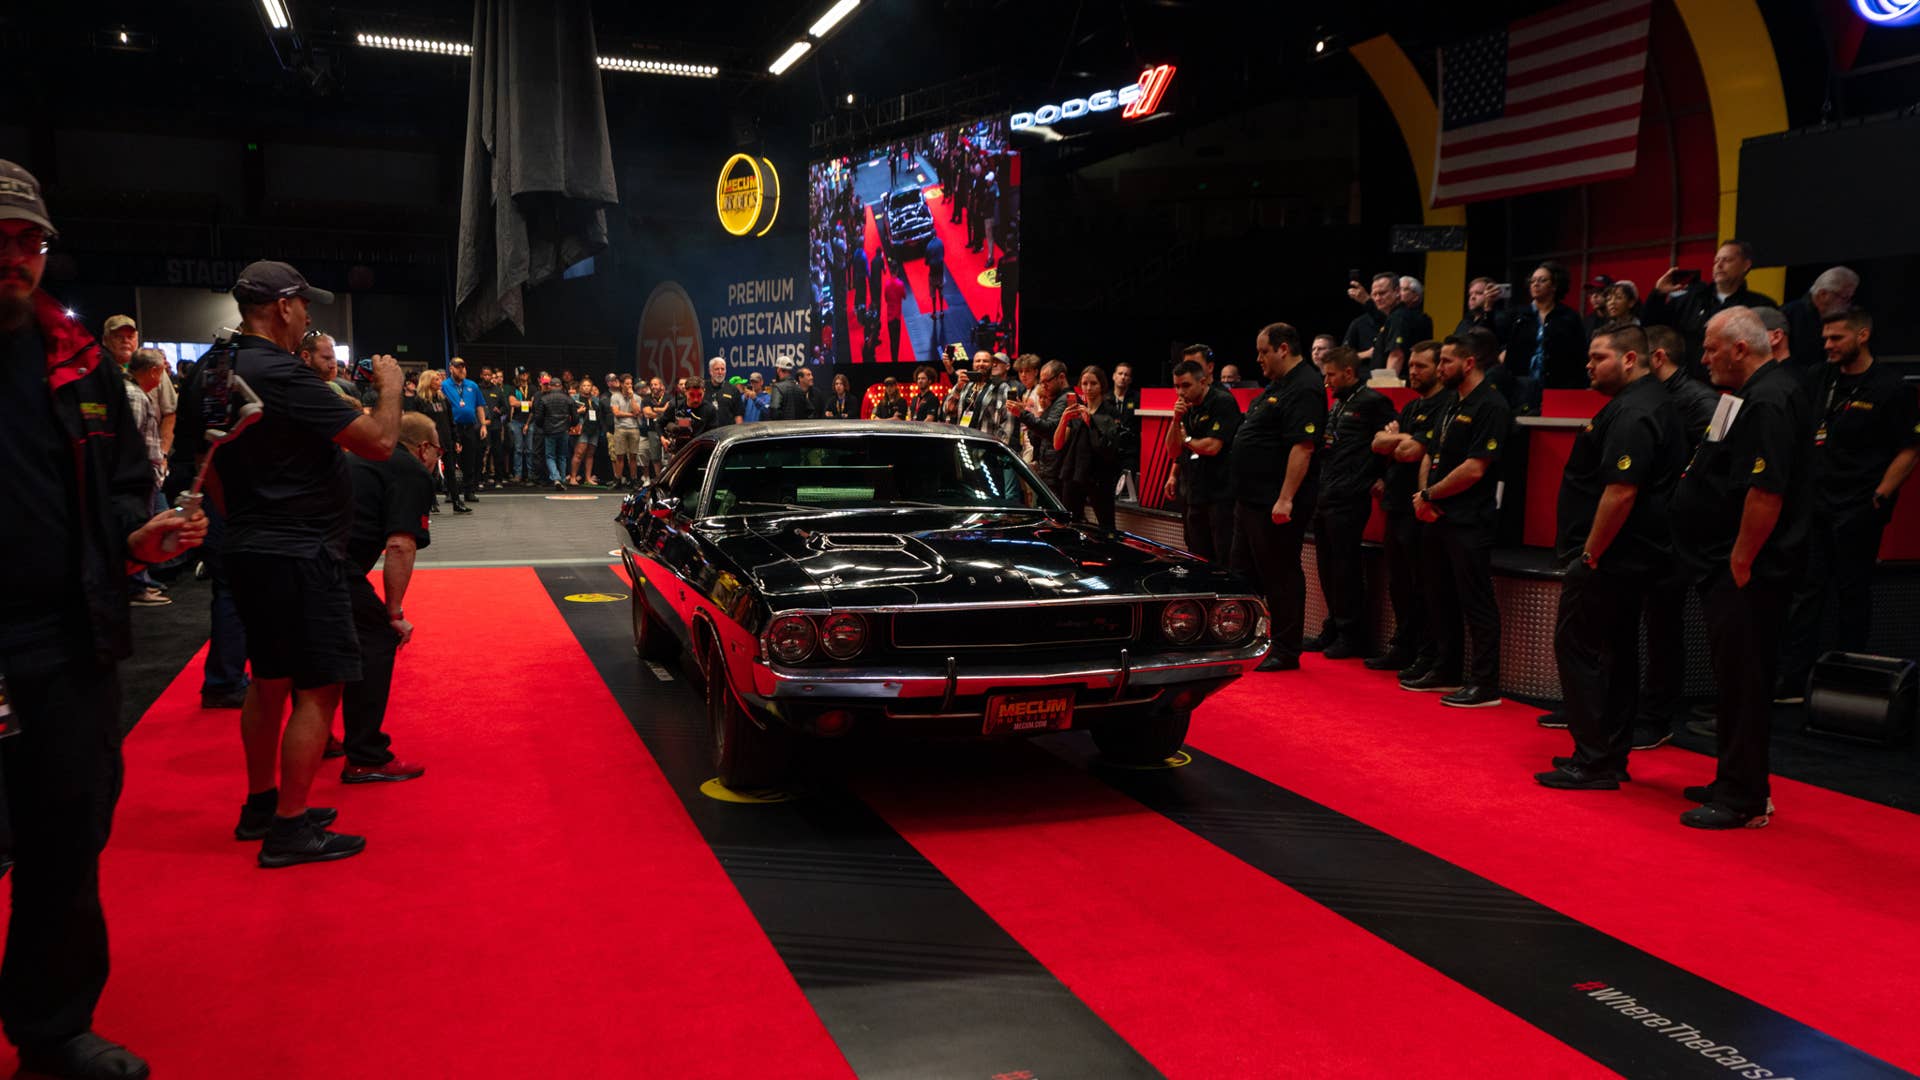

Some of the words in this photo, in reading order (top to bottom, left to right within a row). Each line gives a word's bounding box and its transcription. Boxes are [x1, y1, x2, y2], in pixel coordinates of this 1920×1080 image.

[1010, 83, 1142, 131] DODGE
[728, 277, 794, 306] PREMIUM
[711, 307, 812, 338] PROTECTANTS
[643, 335, 695, 390] 303
[729, 343, 805, 368] CLEANERS
[999, 698, 1067, 717] MECUM
[1572, 980, 1796, 1080] #WhereTheCars
